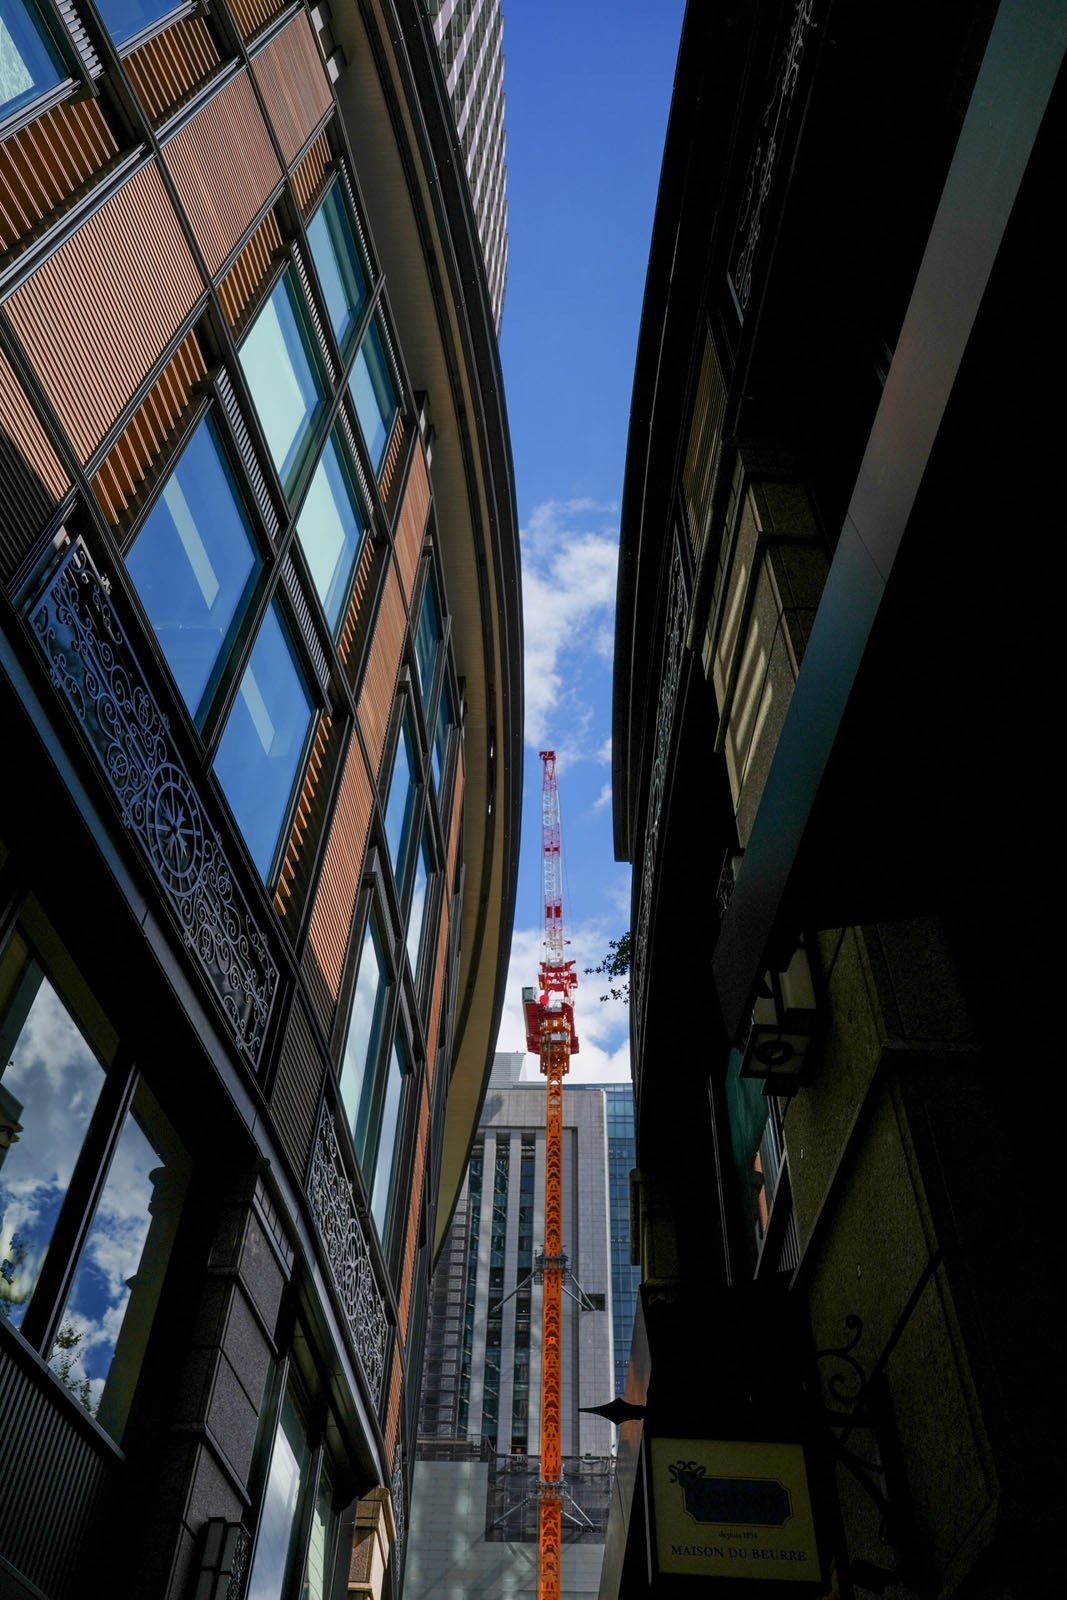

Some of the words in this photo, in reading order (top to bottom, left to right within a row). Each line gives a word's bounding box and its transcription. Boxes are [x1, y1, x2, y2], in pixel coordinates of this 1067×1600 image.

[671, 1545, 724, 1558] MAISON
[727, 1547, 746, 1559] DU
[752, 1548, 808, 1561] BEURRE
